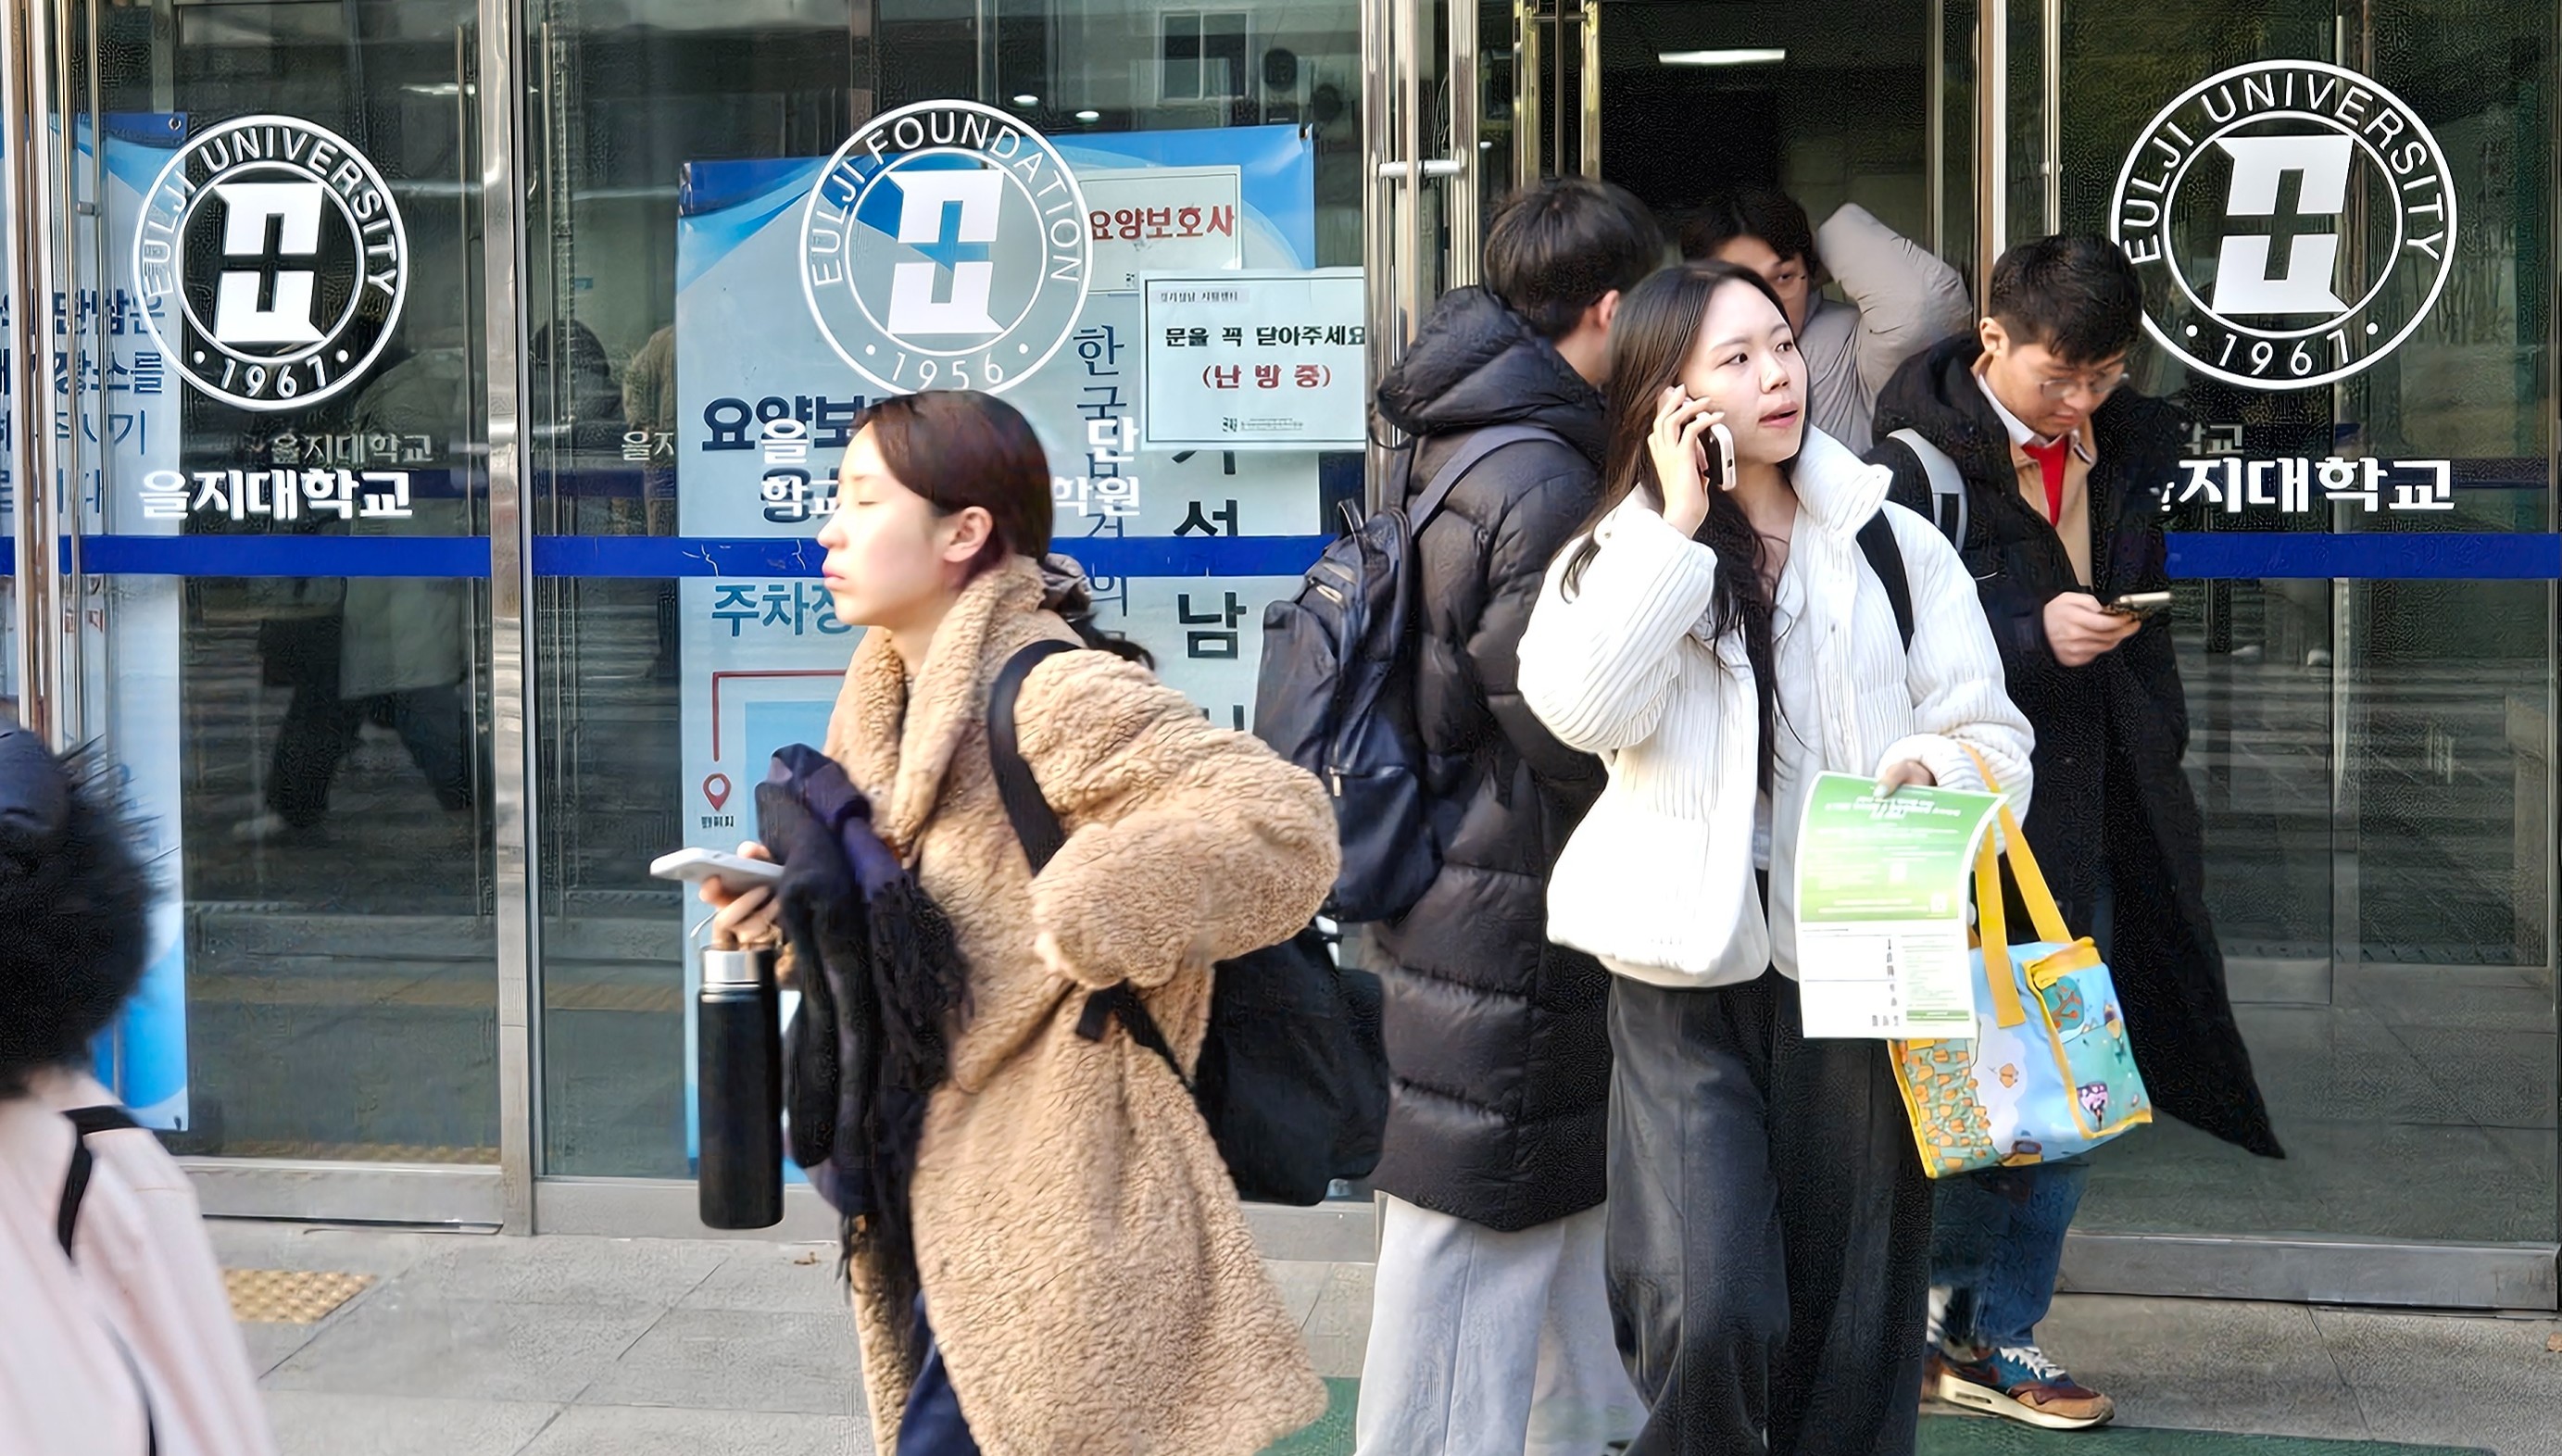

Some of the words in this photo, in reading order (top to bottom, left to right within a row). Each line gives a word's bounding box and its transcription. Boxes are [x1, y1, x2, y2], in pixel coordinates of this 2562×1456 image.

[2124, 120, 2194, 265] EULJI
[2202, 71, 2443, 262] UNIVERSITY
[144, 169, 197, 296] EULJI
[200, 126, 398, 296] UNIVERSITY
[810, 160, 866, 286] EULJI
[865, 110, 1084, 282] FOUNDATION
[1089, 204, 1236, 241] 요양보호사
[1165, 326, 1209, 347] 문을
[1222, 326, 1243, 347] 꼭
[1256, 324, 1365, 347] 닫아주세요
[2218, 331, 2351, 376] 1967
[219, 358, 328, 398] 1967
[892, 351, 1004, 390] 1956
[702, 394, 878, 451] 요양보
[139, 469, 413, 521] 을지대학교
[2160, 457, 2455, 513] 지대학교
